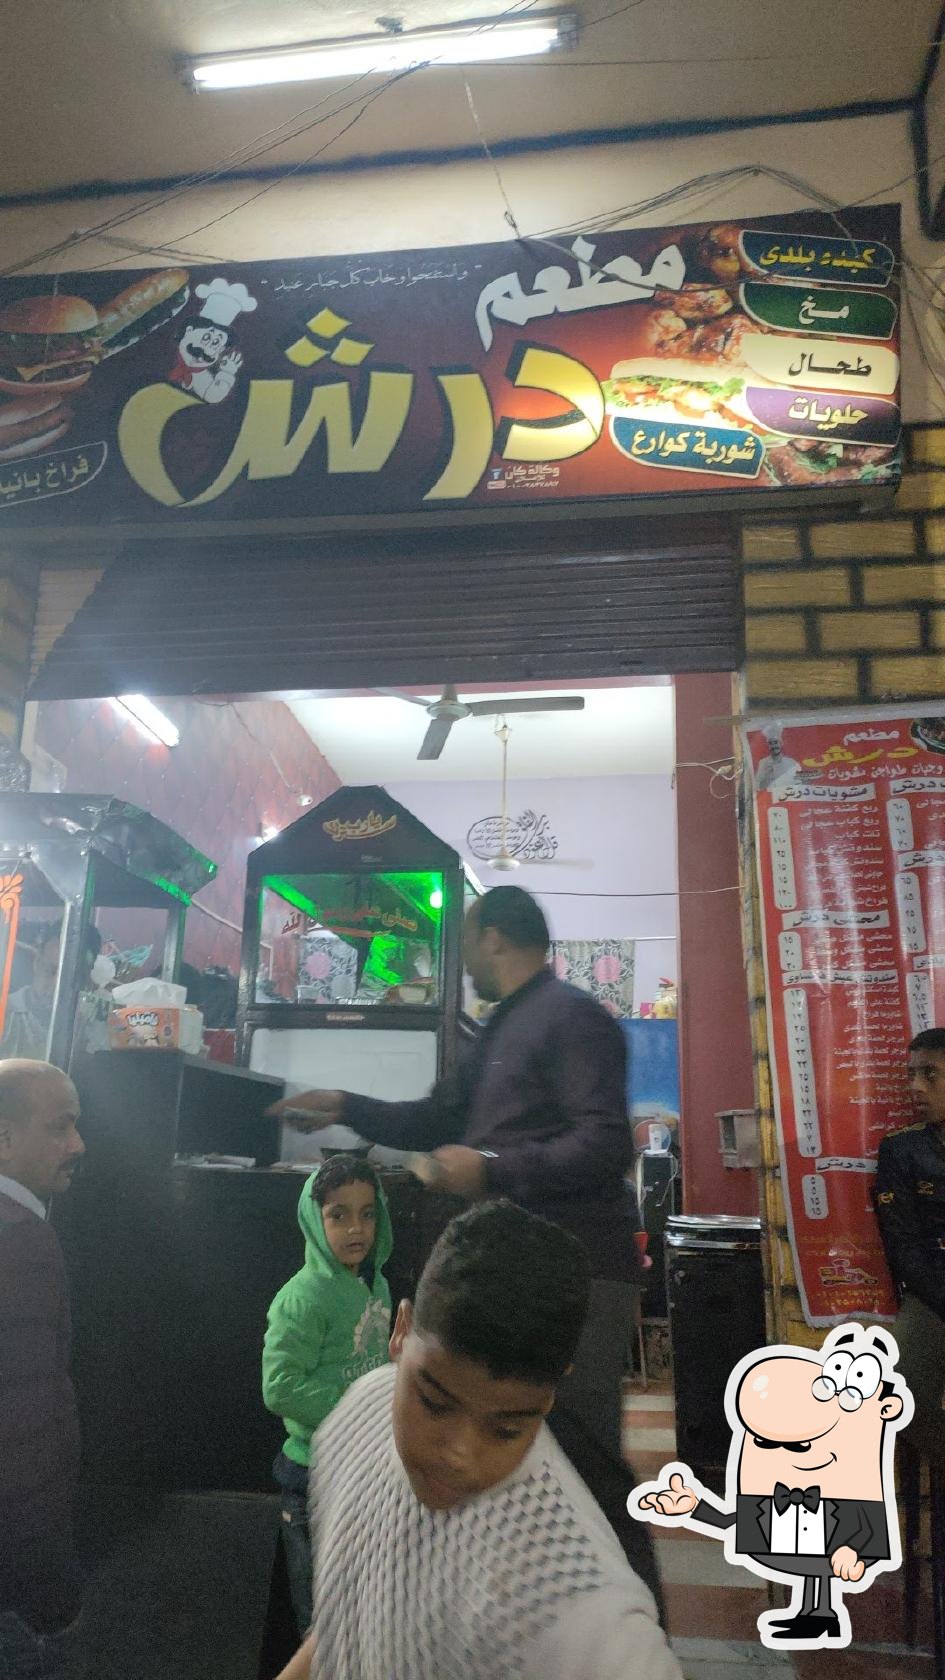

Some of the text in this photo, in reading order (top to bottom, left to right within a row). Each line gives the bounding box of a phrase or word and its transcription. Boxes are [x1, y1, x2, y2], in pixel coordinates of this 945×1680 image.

[475, 236, 686, 352] مطعم
[799, 295, 850, 325] مخ
[788, 351, 873, 377] طحال
[118, 307, 605, 508] درش
[788, 396, 869, 431] حلويات
[631, 429, 756, 465] شوربة كوارع
[0, 455, 89, 500] فراخ باني
[843, 728, 900, 746] مطعم
[802, 746, 919, 768] درش
[911, 763, 943, 776] وجبات
[871, 764, 908, 779] طواجن
[812, 785, 868, 801] مشويات
